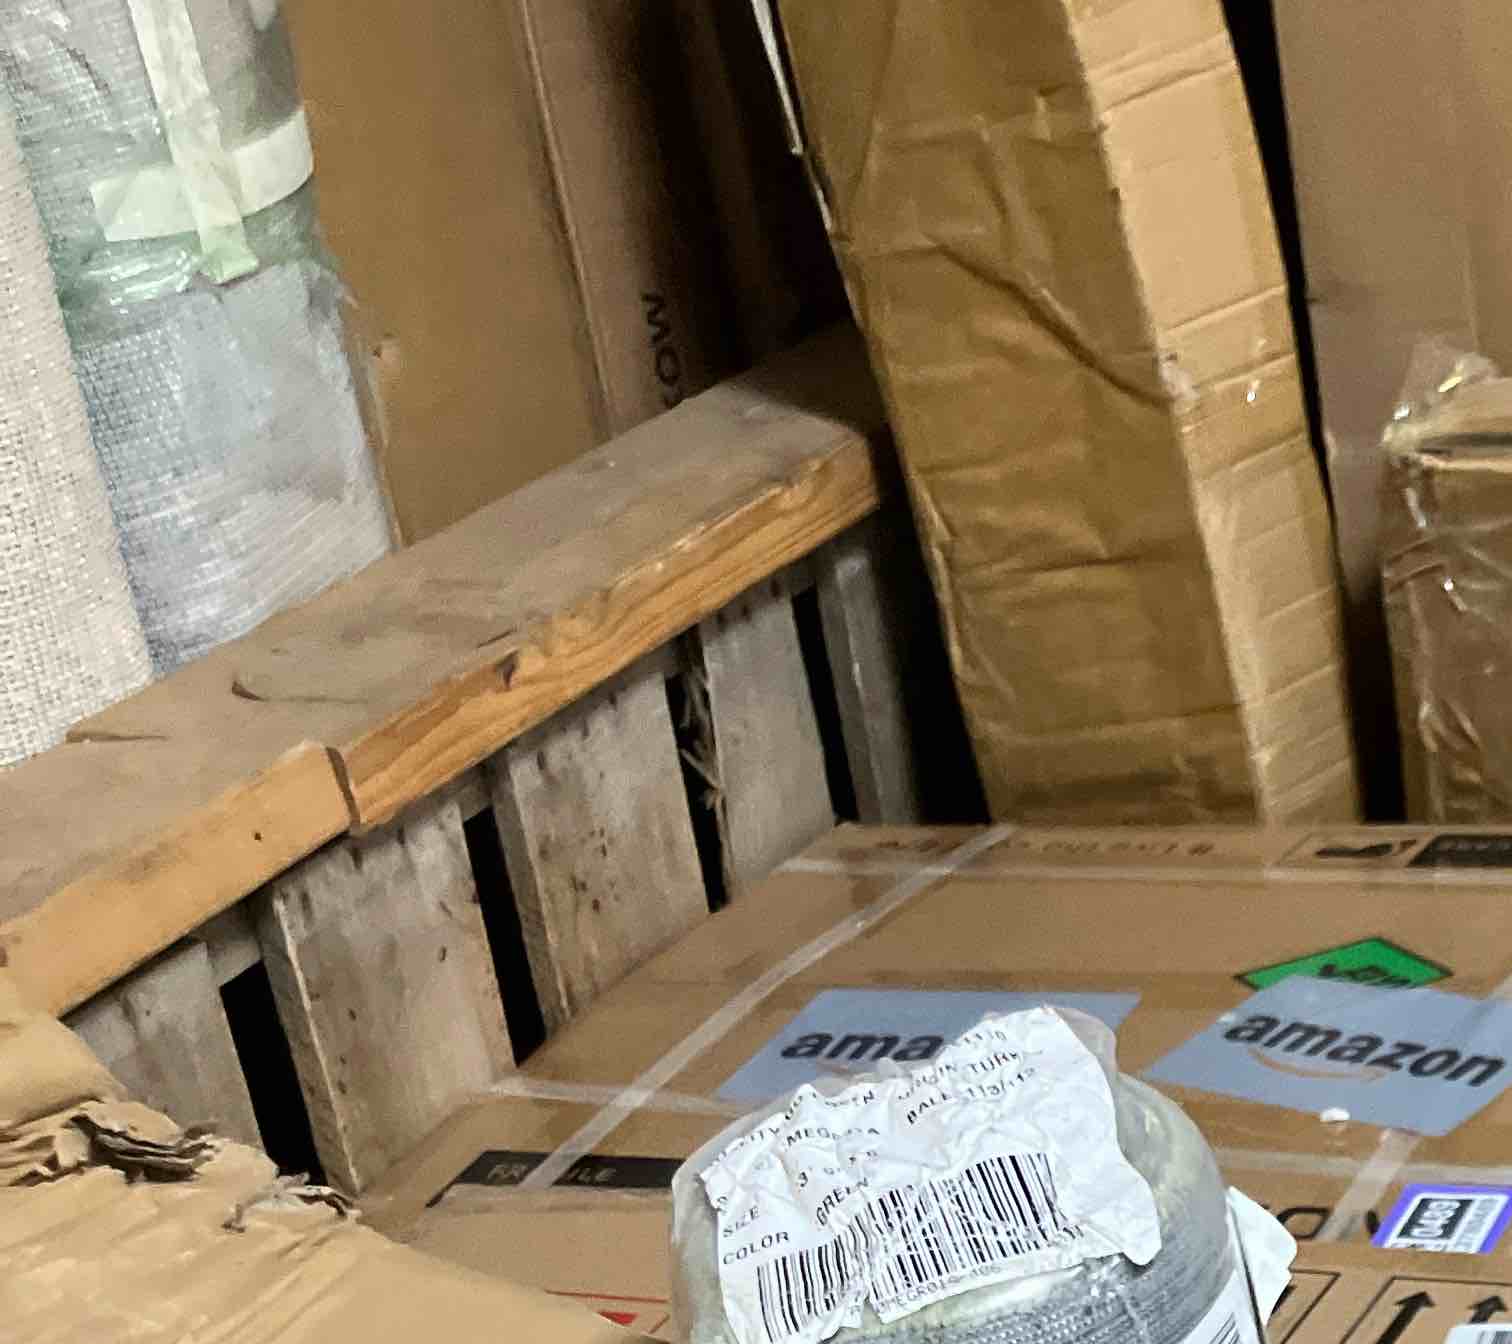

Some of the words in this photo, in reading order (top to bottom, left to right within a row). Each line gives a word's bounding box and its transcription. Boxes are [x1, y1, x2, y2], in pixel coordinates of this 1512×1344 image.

[780, 1032, 946, 1062] ama
[1223, 1014, 1507, 1088] amazon
[487, 1163, 618, 1184] FRILE
[723, 1230, 791, 1266] COLOR
